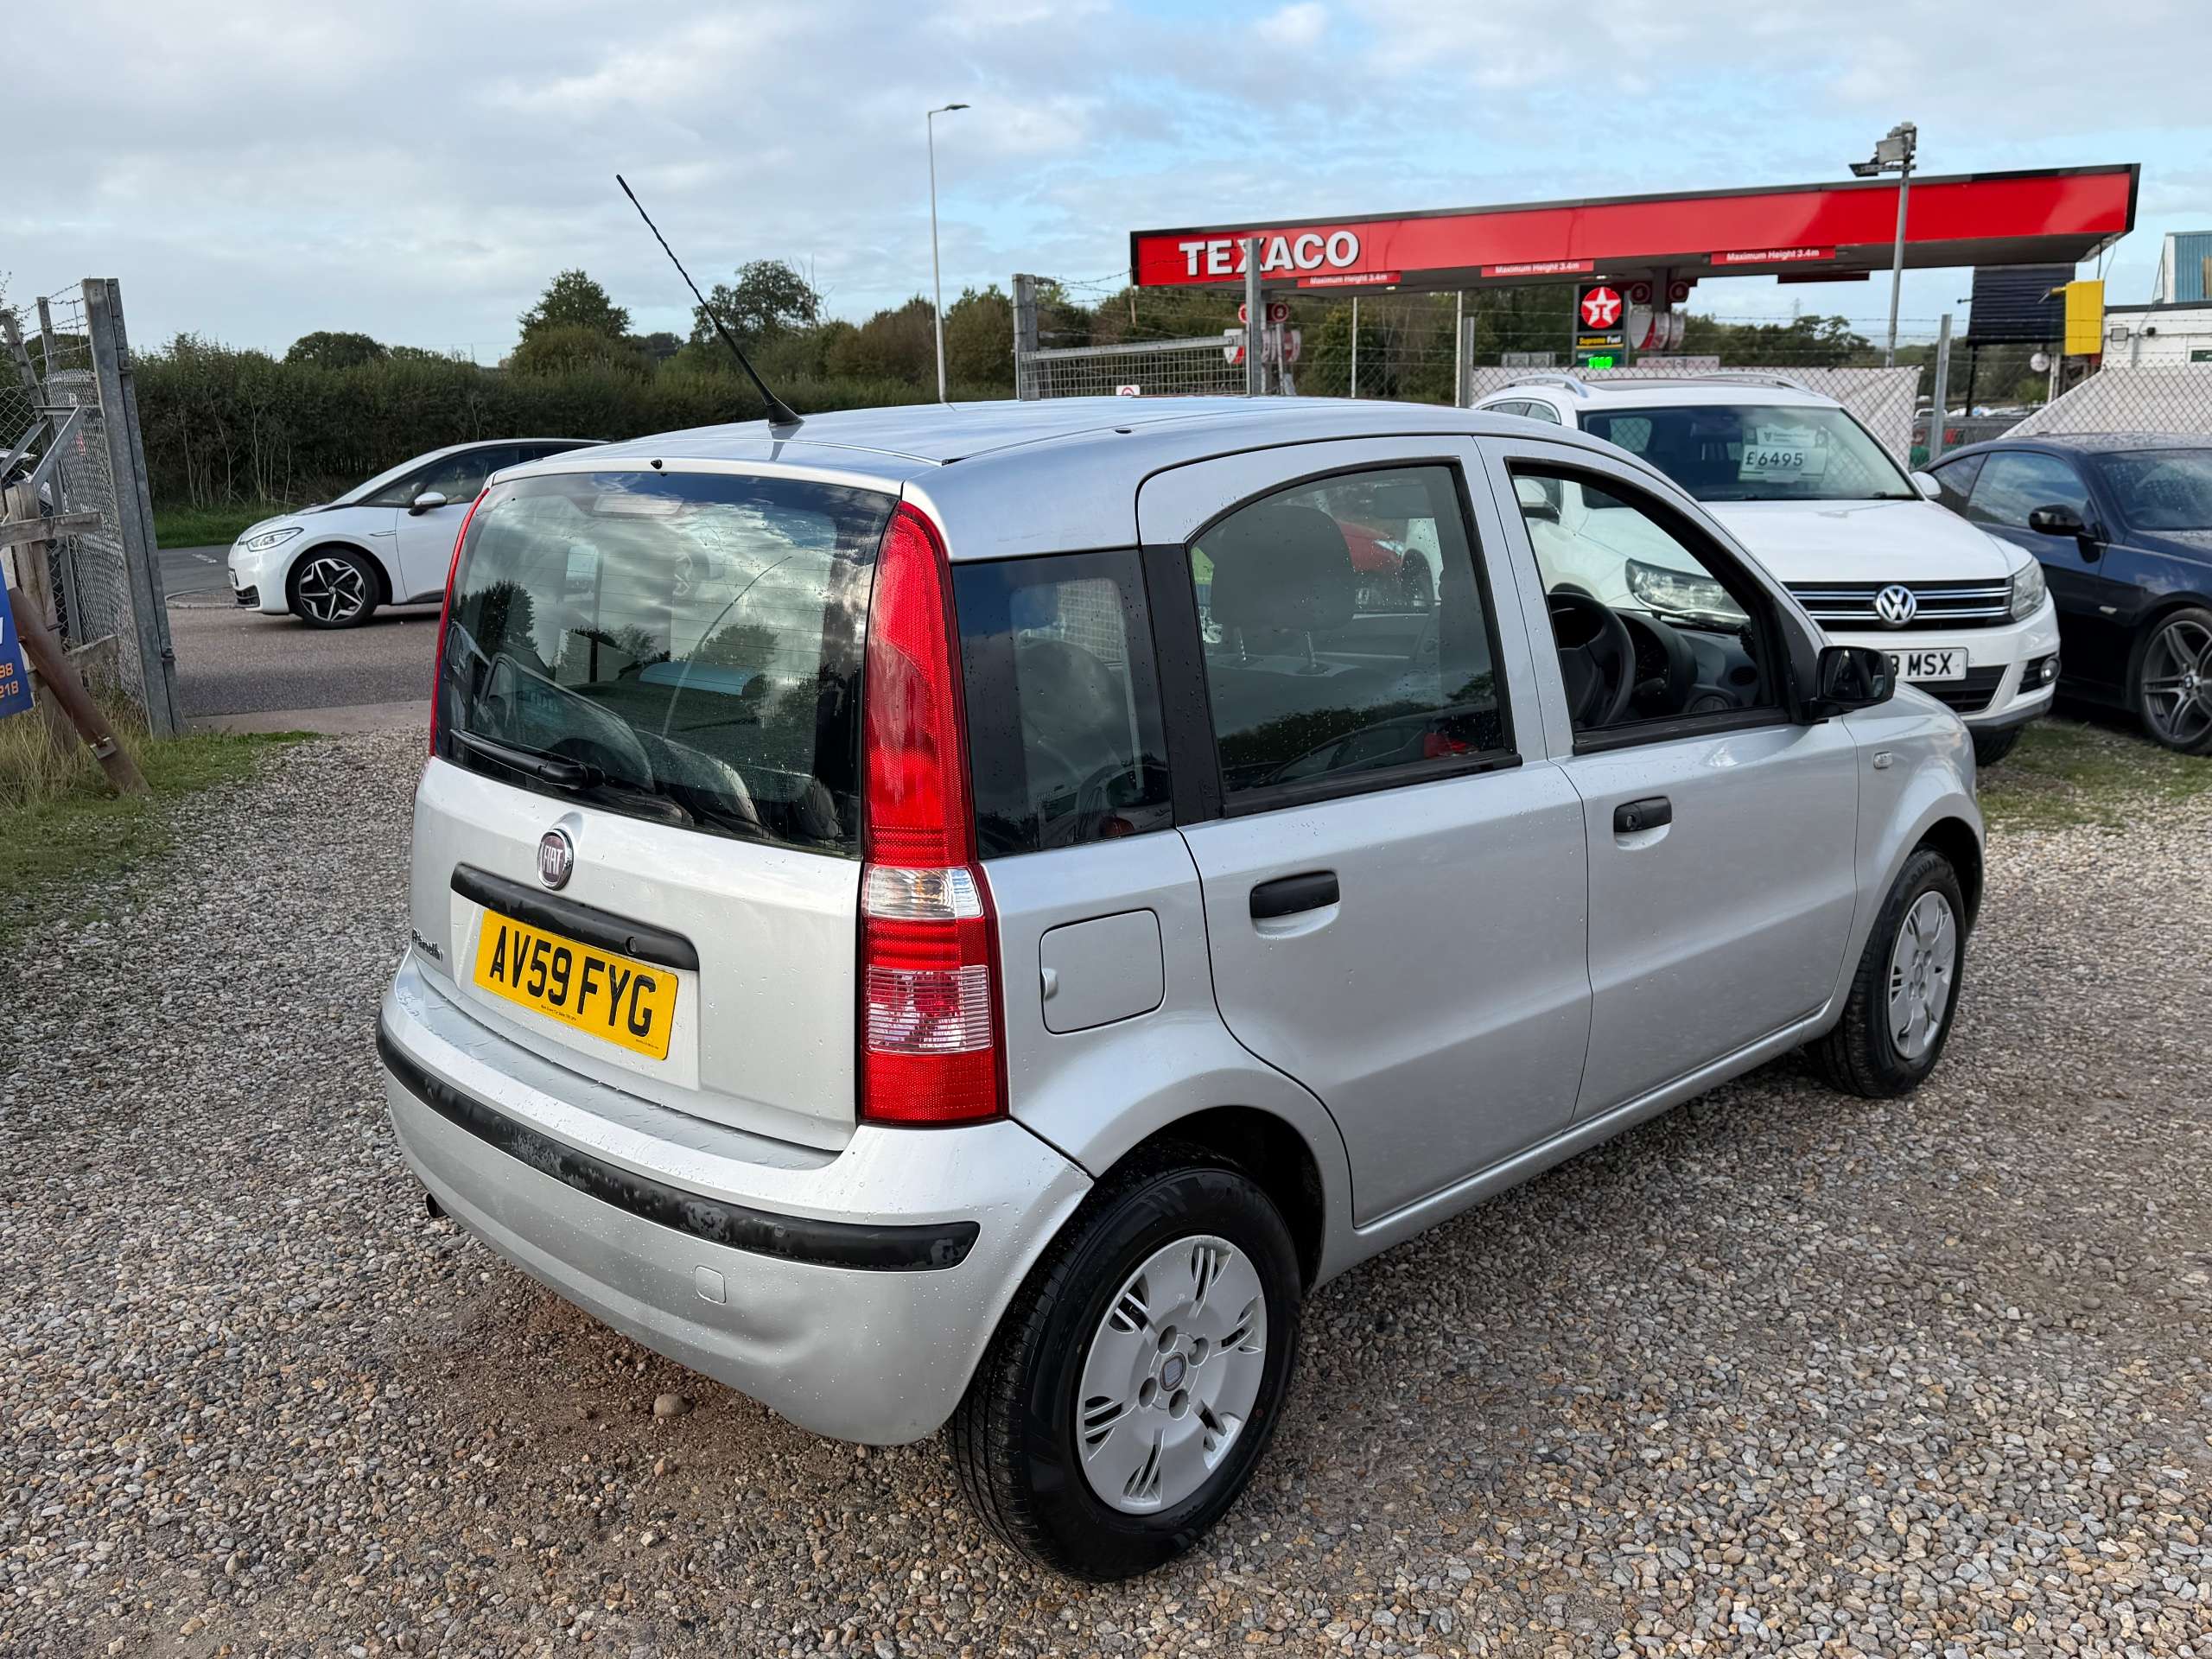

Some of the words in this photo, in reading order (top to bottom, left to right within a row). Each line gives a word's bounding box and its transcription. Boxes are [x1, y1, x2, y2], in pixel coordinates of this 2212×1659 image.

[1726, 252, 1767, 262] Maximum
[1767, 250, 1796, 261] Height
[1797, 249, 1820, 258] 3.4m
[1495, 264, 1532, 274] Maximum
[1532, 263, 1559, 273] Height
[1559, 262, 1580, 270] 3.4m
[1309, 276, 1344, 285] Maximum
[1344, 274, 1368, 284] Height
[1745, 451, 1803, 467] £6495
[1907, 652, 1953, 677] MSX
[543, 844, 564, 875] FIAT
[489, 925, 572, 1007] AV59
[576, 956, 657, 1038] FYG
